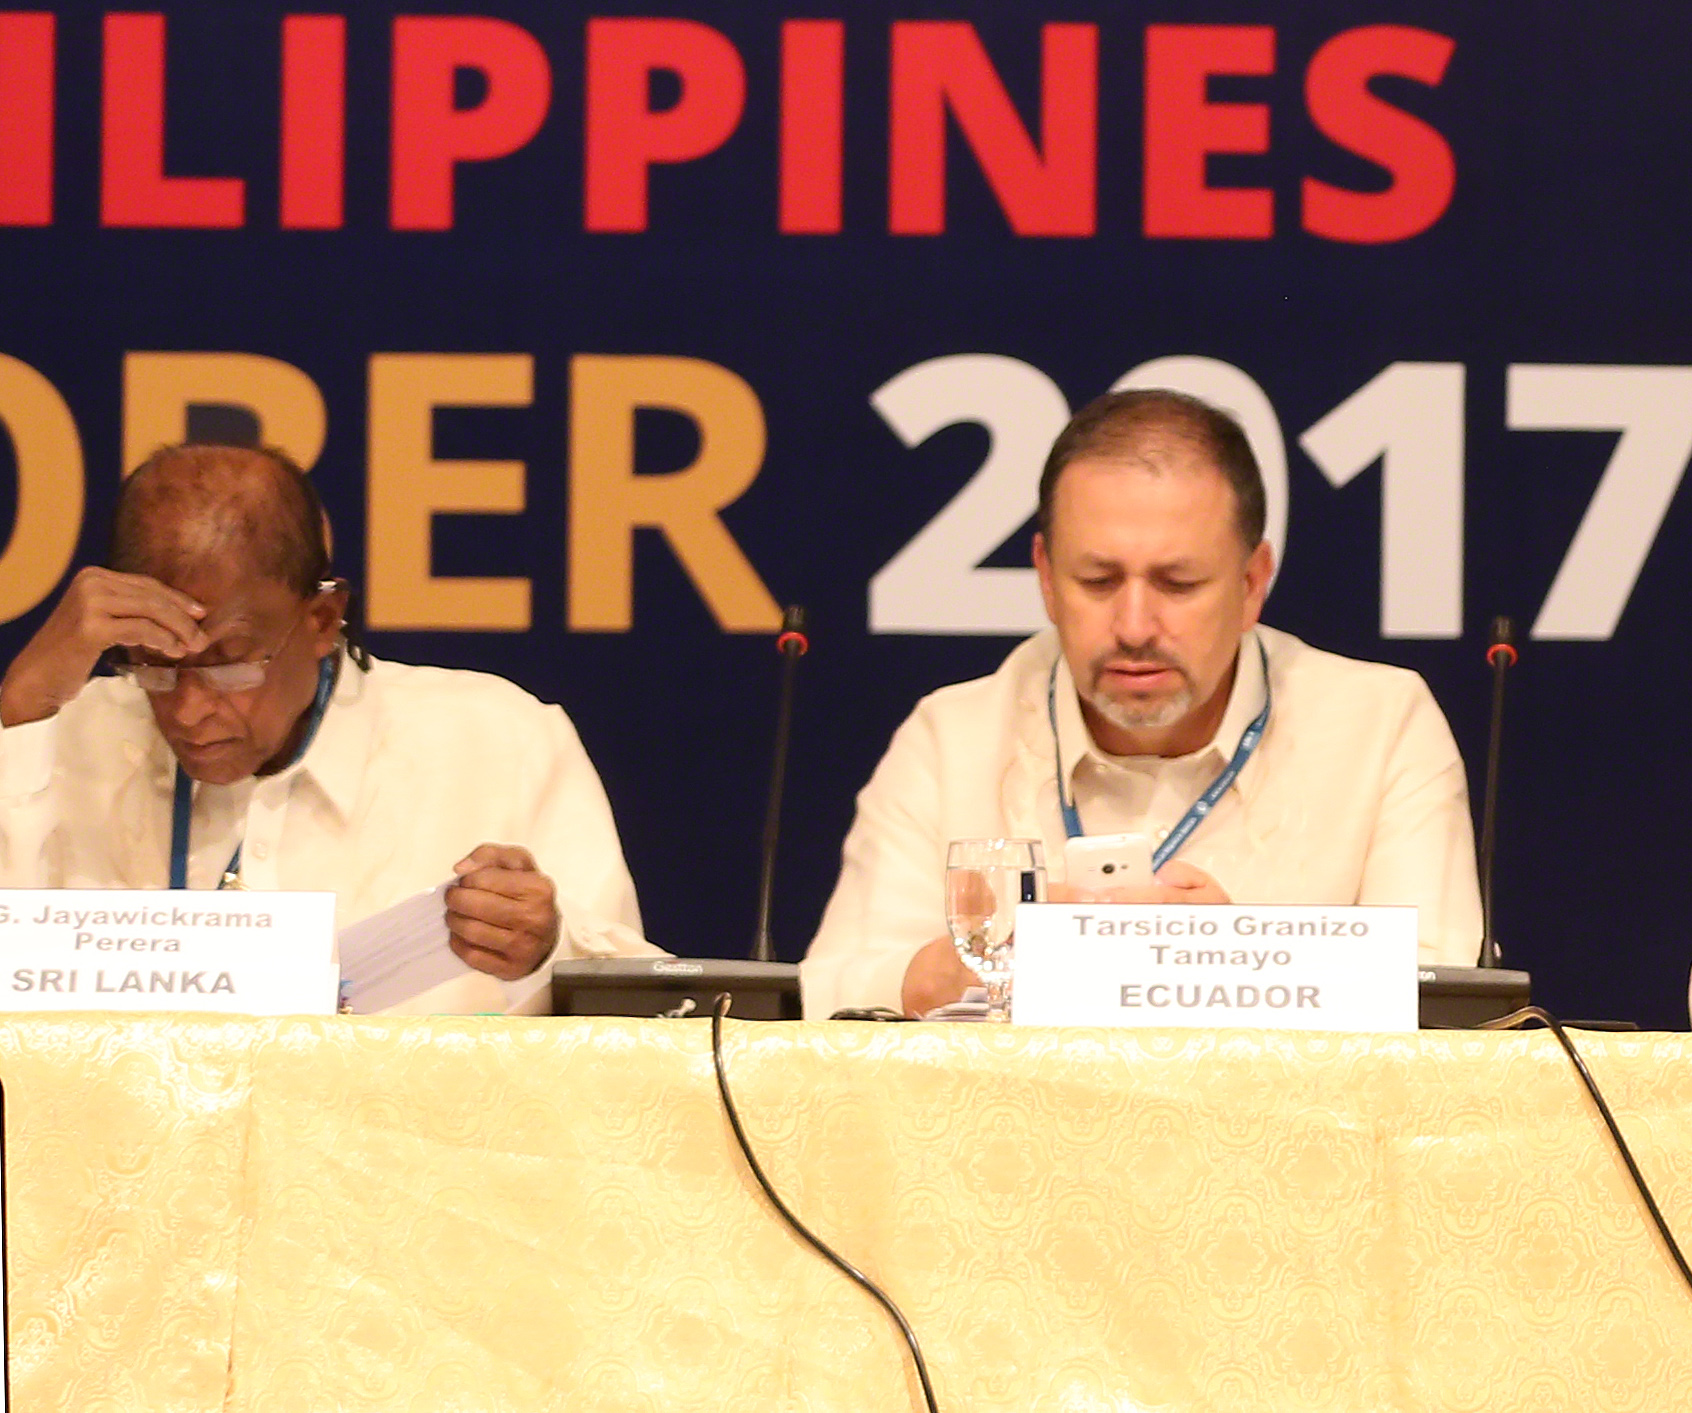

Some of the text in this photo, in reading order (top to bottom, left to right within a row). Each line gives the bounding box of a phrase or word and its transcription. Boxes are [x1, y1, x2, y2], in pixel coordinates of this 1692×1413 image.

[33, 905, 272, 930] Jayawickrama
[1072, 915, 1369, 937] Tarsicio Granizo
[75, 932, 180, 952] Perera
[1149, 944, 1291, 971] Tamayo
[12, 969, 236, 994] SRI LANKA
[1120, 984, 1321, 1008] ECUADOR
